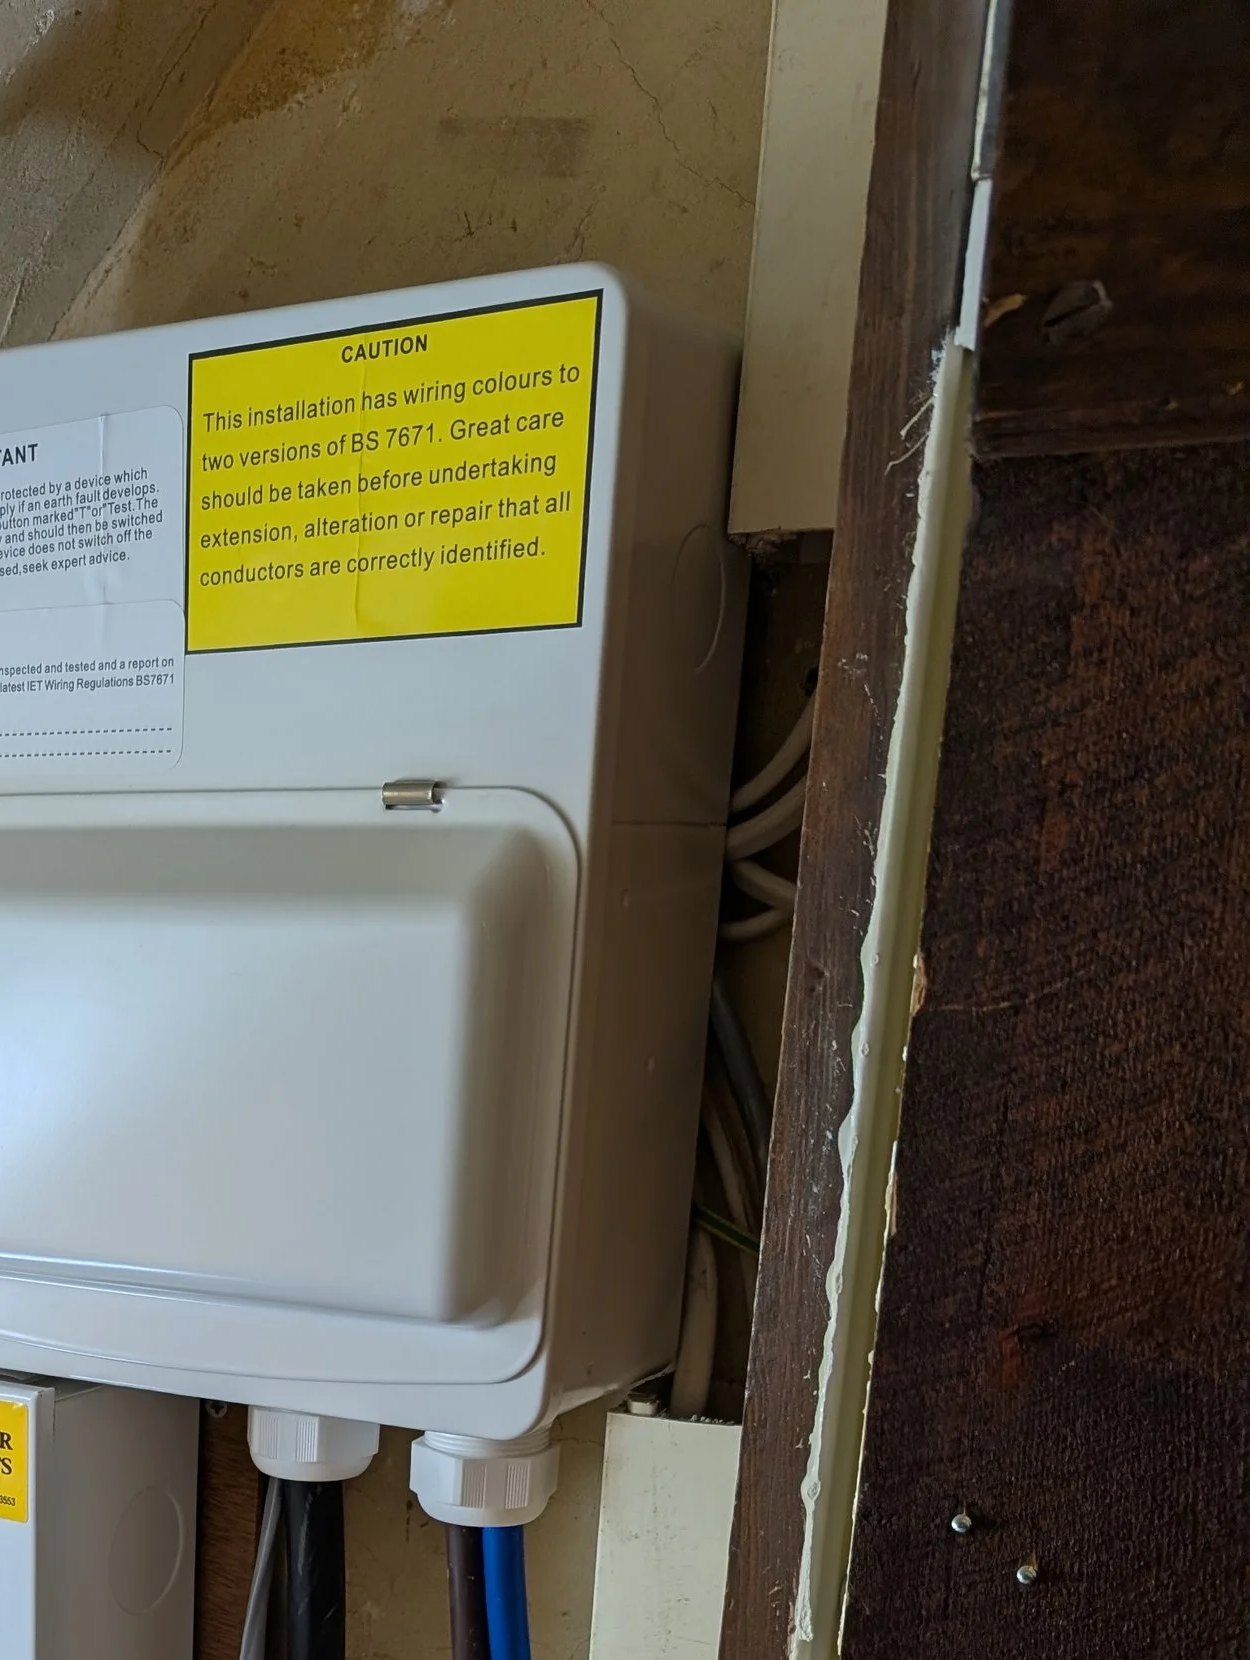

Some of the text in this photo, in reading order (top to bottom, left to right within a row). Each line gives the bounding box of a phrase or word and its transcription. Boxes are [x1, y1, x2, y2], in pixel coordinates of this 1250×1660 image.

[340, 334, 427, 363] CAUTION
[203, 363, 579, 432] This installation has wiring colours to
[202, 412, 563, 471] two versions of BS 7671. Great care
[48, 481, 62, 496] by
[64, 481, 71, 491] a
[74, 474, 110, 490] device
[113, 467, 147, 484] which
[201, 454, 556, 510] should be taken before undertaking
[18, 500, 25, 513] if
[27, 500, 41, 511] an
[43, 493, 72, 509] earth
[75, 489, 100, 504] fault
[102, 483, 159, 500] develops.
[200, 491, 570, 548] extension, alteration or repair that all
[50, 553, 86, 571] expert
[200, 537, 544, 586] conductors are correctly identified.
[44, 661, 62, 673] and
[64, 660, 95, 672] tested
[98, 659, 117, 670] and
[119, 661, 125, 669] a
[128, 656, 159, 671] report
[161, 658, 174, 667] on
[0, 680, 25, 692] latest
[26, 679, 43, 691] IET
[44, 679, 74, 692] Wiring
[76, 676, 134, 691] Regulations
[135, 673, 174, 686] BS7671
